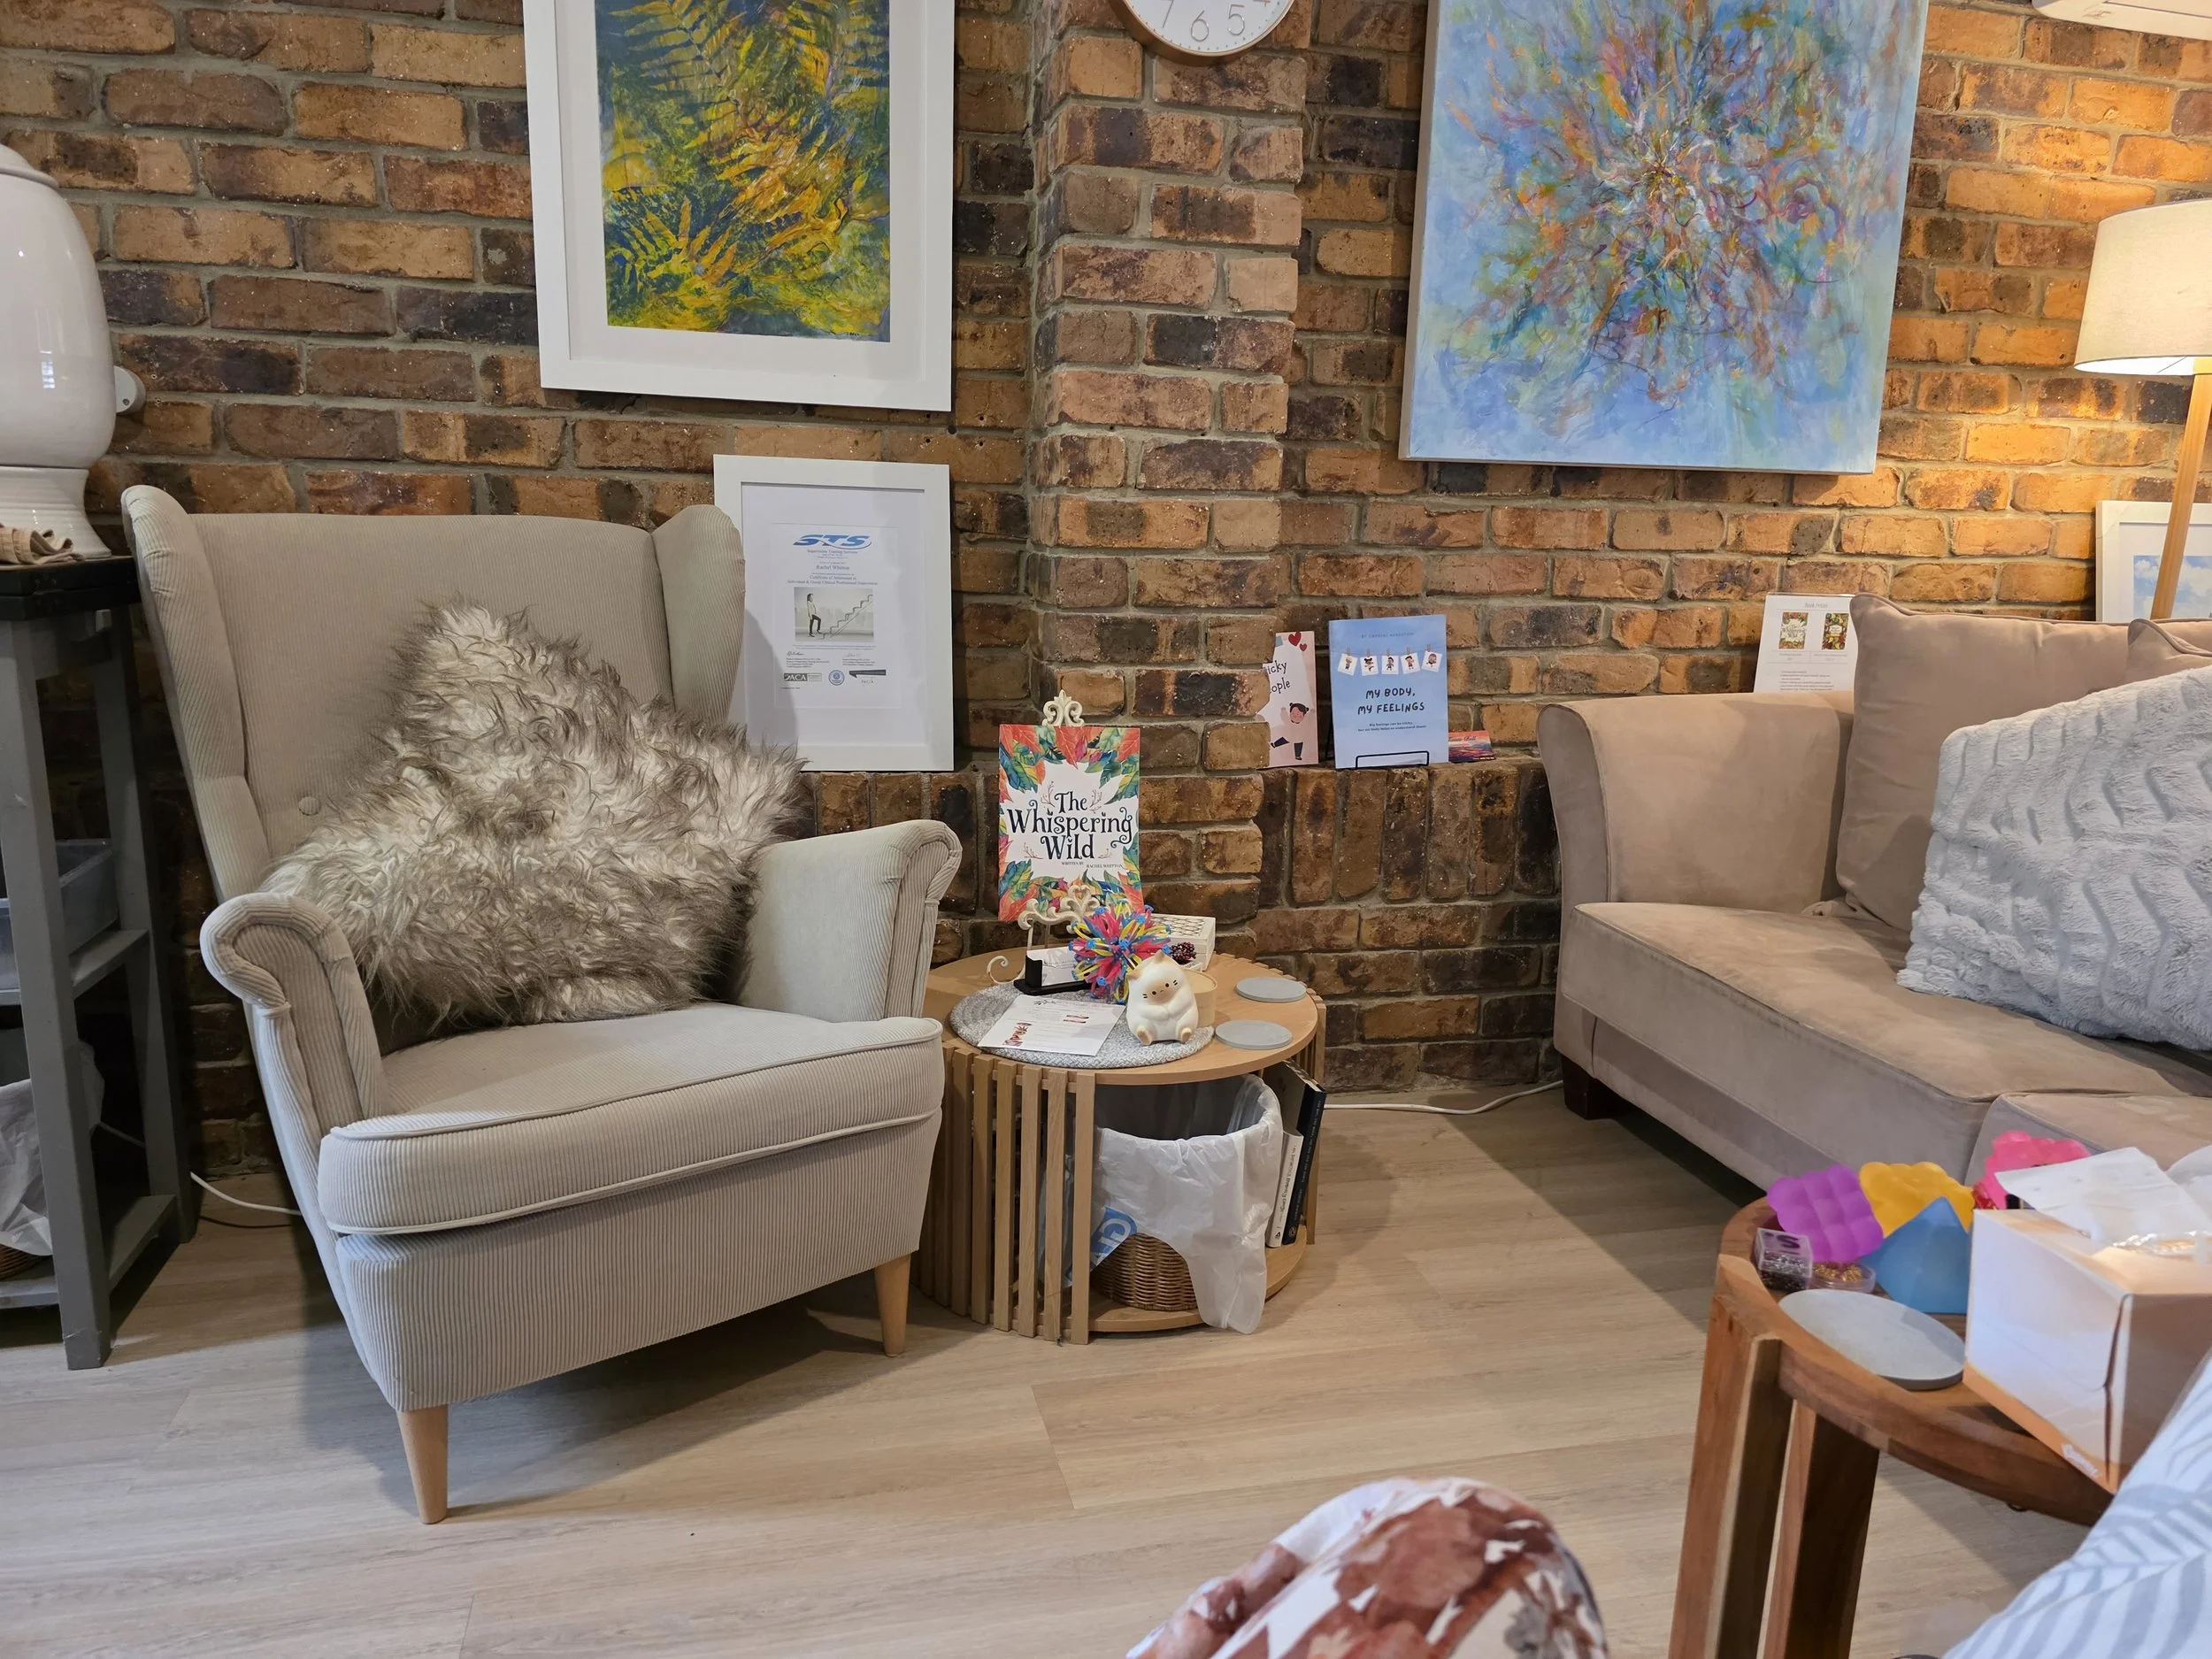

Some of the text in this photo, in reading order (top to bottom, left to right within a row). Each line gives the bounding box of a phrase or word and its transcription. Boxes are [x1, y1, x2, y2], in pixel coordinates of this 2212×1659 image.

[1190, 10, 1210, 42] 6
[1227, 4, 1245, 36] 5
[793, 534, 871, 548] STS
[1267, 659, 1287, 674] icky
[1270, 677, 1291, 695] ople
[1385, 687, 1416, 697] BODY,
[1377, 702, 1425, 714] FEELINGS
[1054, 791, 1088, 814] The
[1006, 799, 1133, 849] Whispering
[1040, 833, 1095, 860] Wild
